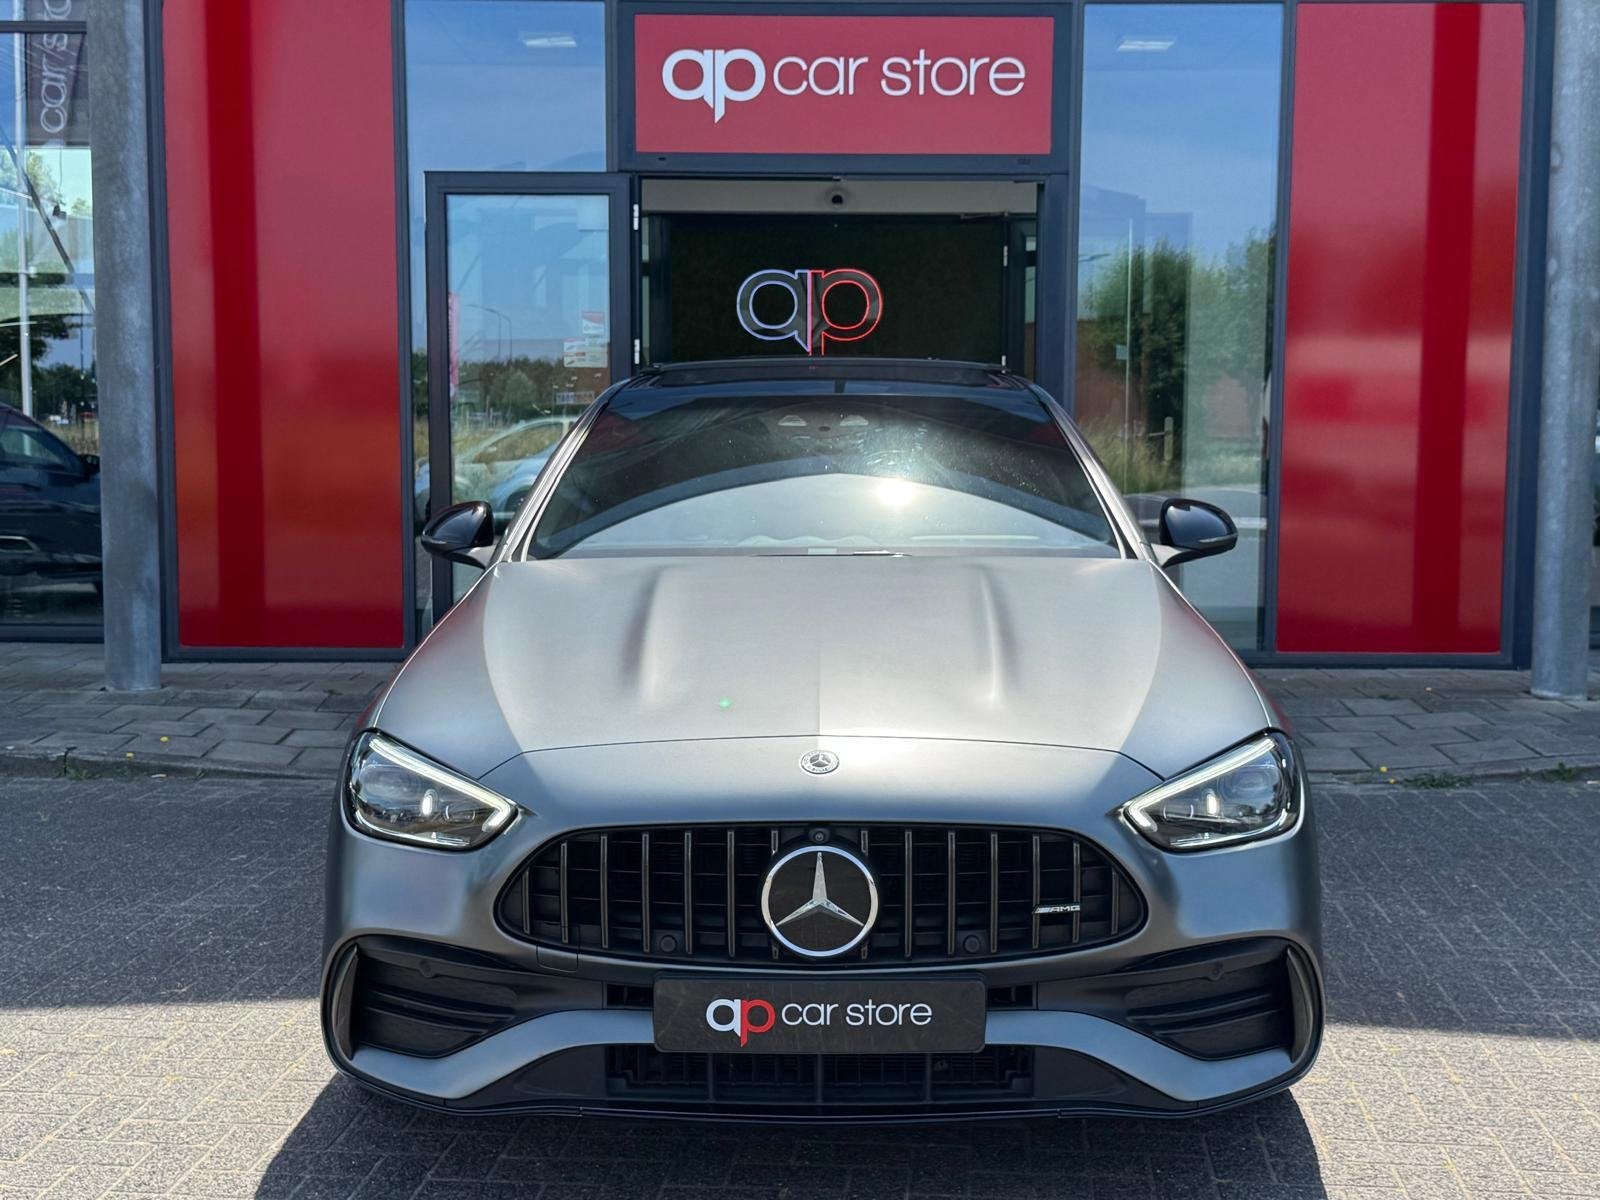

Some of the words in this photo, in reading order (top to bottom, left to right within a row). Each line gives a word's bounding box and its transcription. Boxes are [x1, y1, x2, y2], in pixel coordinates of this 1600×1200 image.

[40, 53, 68, 133] car
[772, 55, 869, 96] car
[880, 48, 1026, 96] store
[781, 1002, 839, 1026] car
[845, 998, 933, 1026] store
